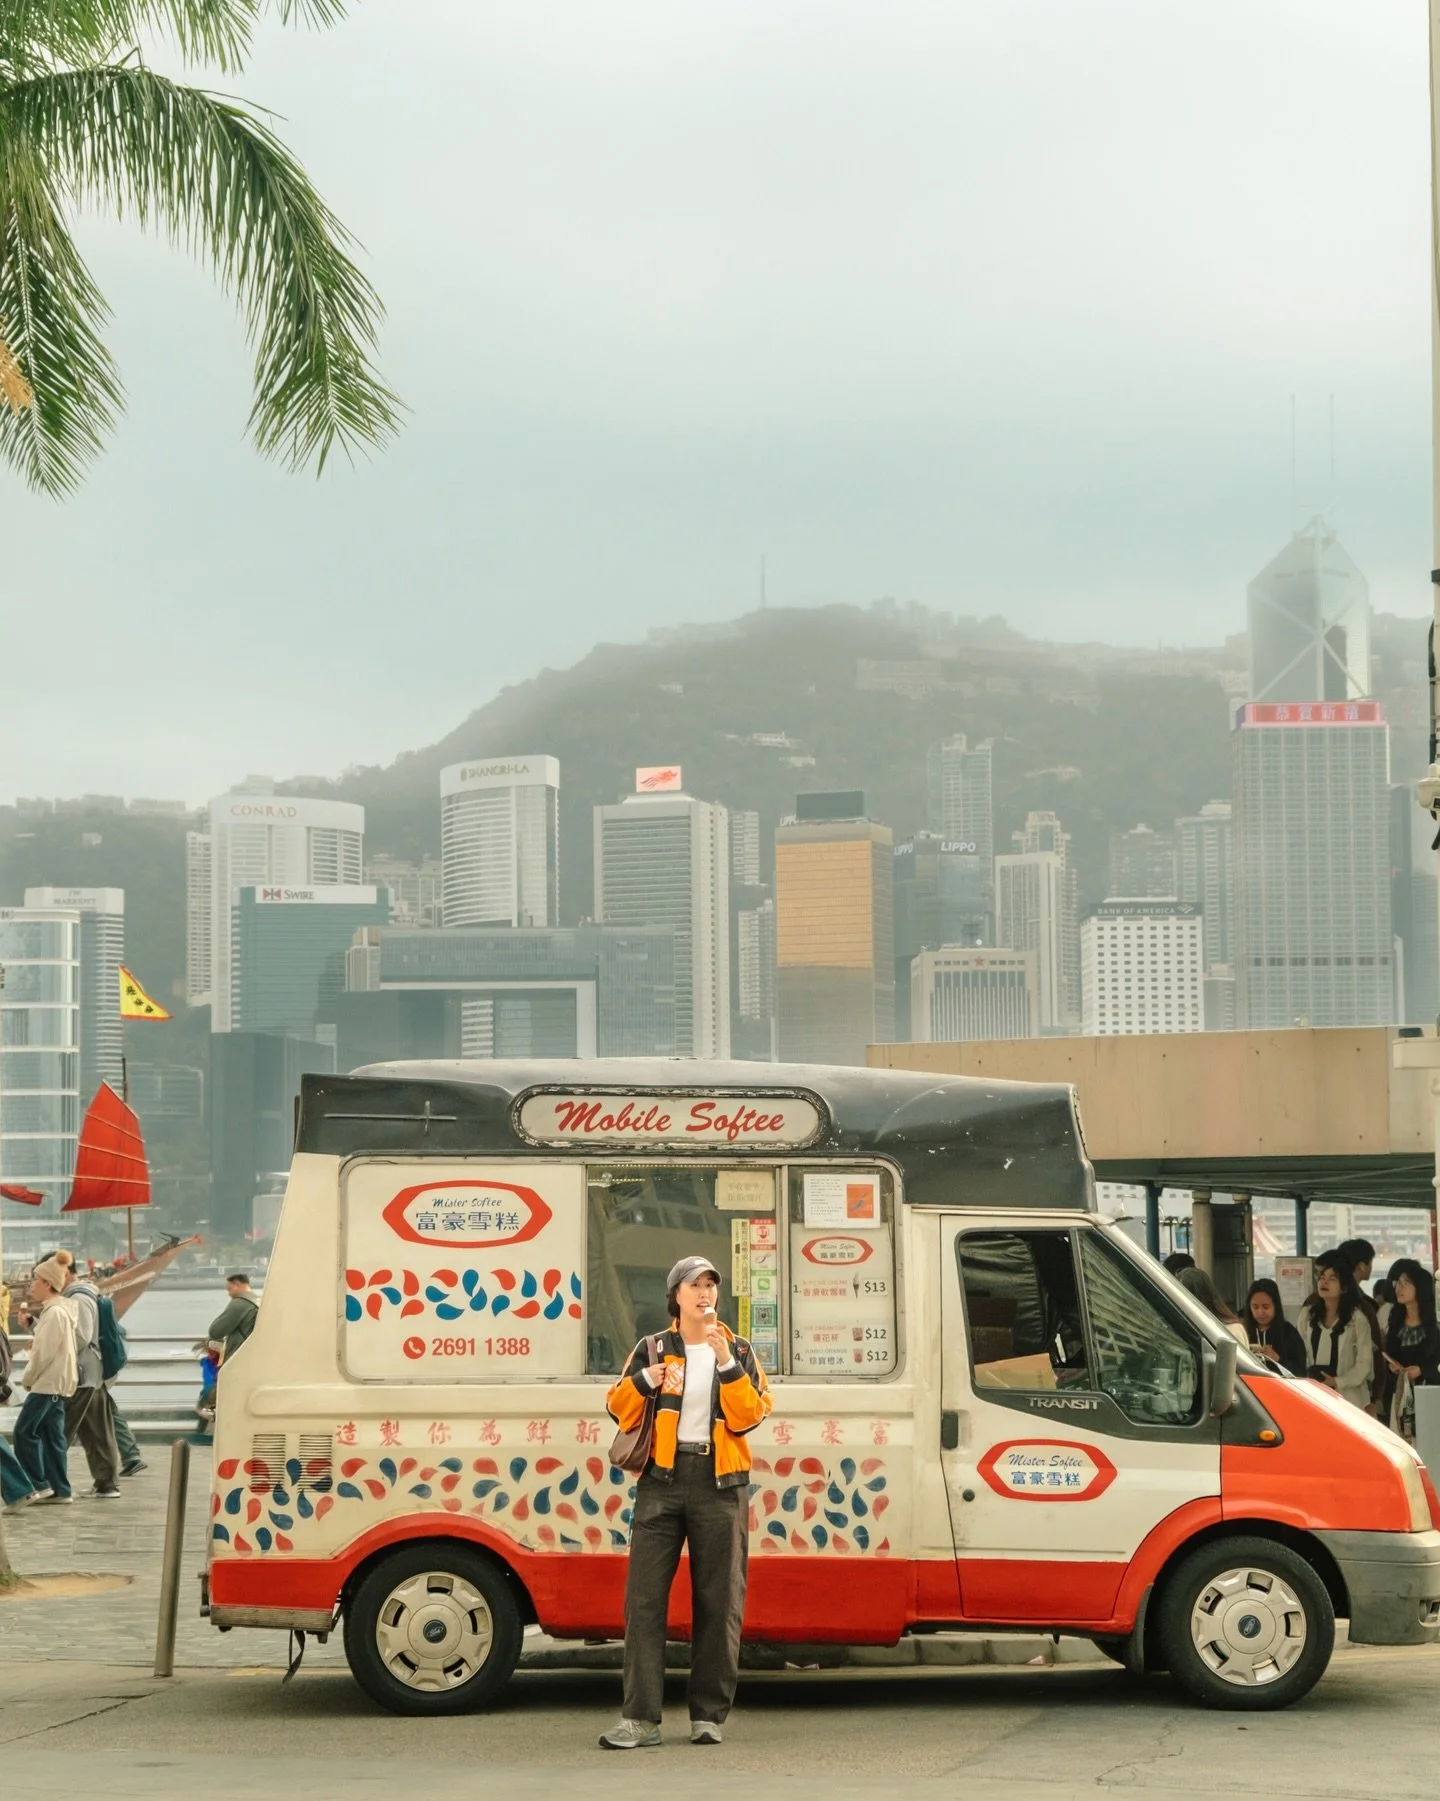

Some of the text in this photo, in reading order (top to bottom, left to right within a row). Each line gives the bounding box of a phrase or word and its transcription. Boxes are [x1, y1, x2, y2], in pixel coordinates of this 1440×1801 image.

[230, 804, 297, 818] CONRAD
[941, 841, 977, 852] LIPPO
[1097, 907, 1121, 915] BANK
[1136, 907, 1176, 915] AMERICA
[555, 1101, 785, 1141] Mobile Softee
[432, 1197, 502, 1208] Mister Softee
[415, 1211, 520, 1231] 富豪雪糕
[864, 1281, 886, 1293] $13
[794, 1330, 803, 1339] 3.
[865, 1328, 887, 1340] $12
[431, 1337, 530, 1356] 2691 1388
[794, 1353, 804, 1362] 4.
[867, 1350, 888, 1362] $12
[1027, 1398, 1102, 1410] TRANSIT
[1008, 1453, 1084, 1470] Mister Softee
[1010, 1471, 1081, 1486] 富豪雪糕
